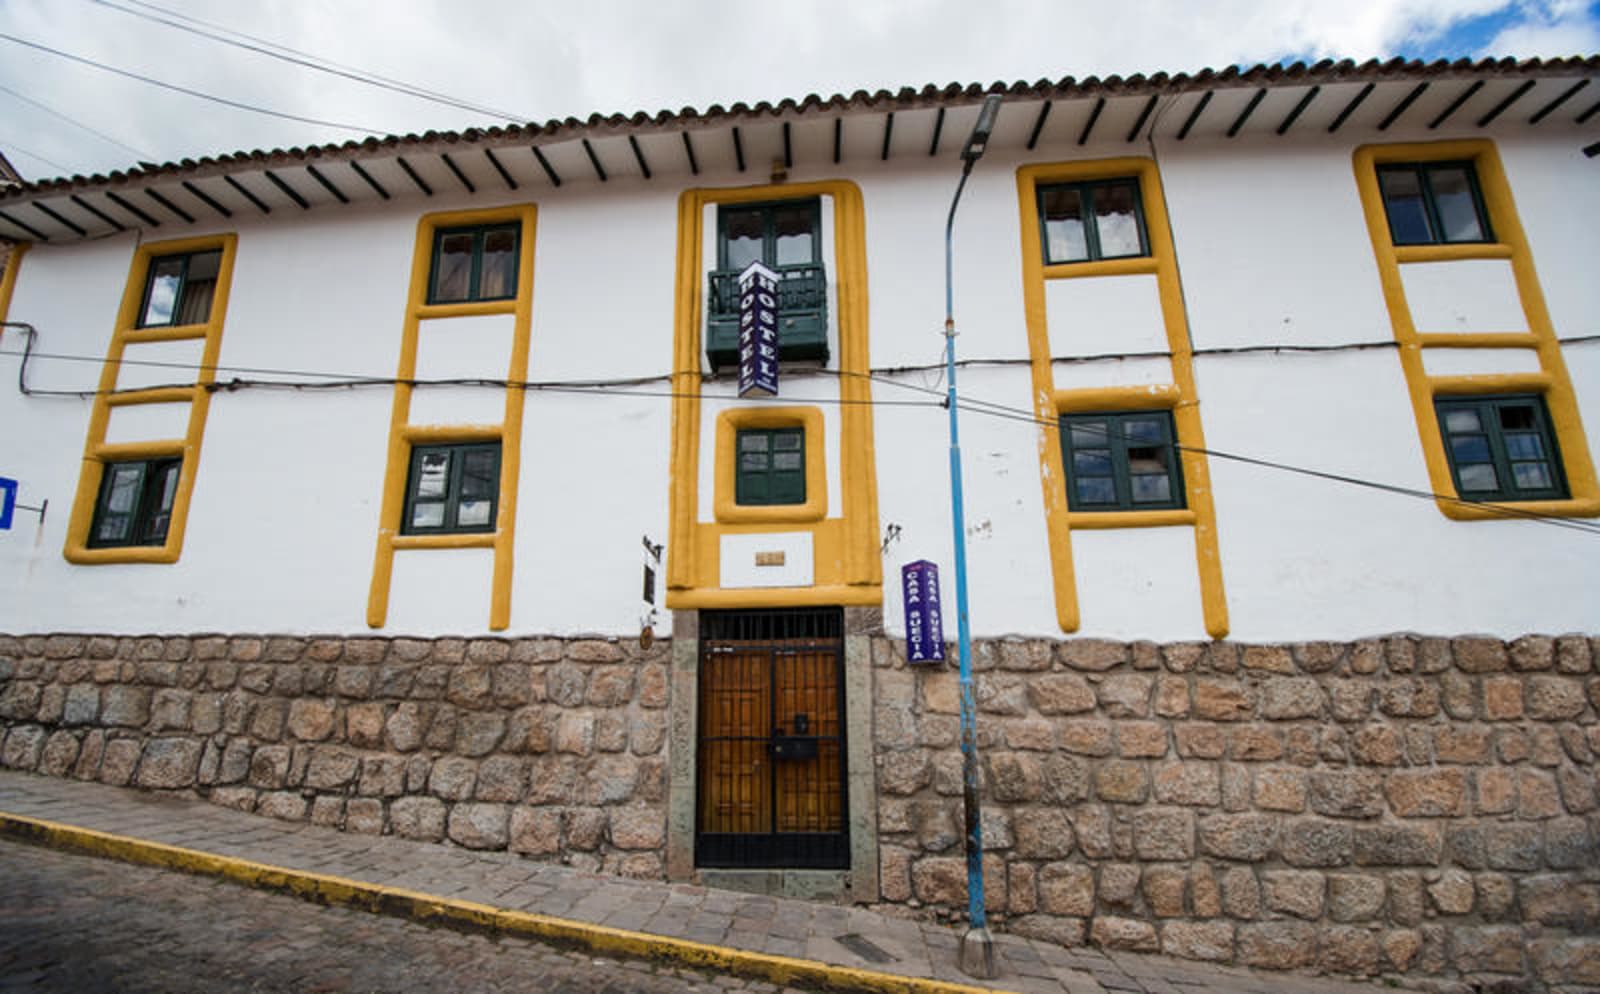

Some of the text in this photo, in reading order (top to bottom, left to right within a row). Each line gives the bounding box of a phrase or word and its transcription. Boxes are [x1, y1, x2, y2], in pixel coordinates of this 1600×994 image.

[741, 276, 754, 378] HOSTEL
[757, 275, 775, 377] HOSTEL
[907, 571, 924, 659] CASA SUECIA
[927, 571, 937, 602] CASA
